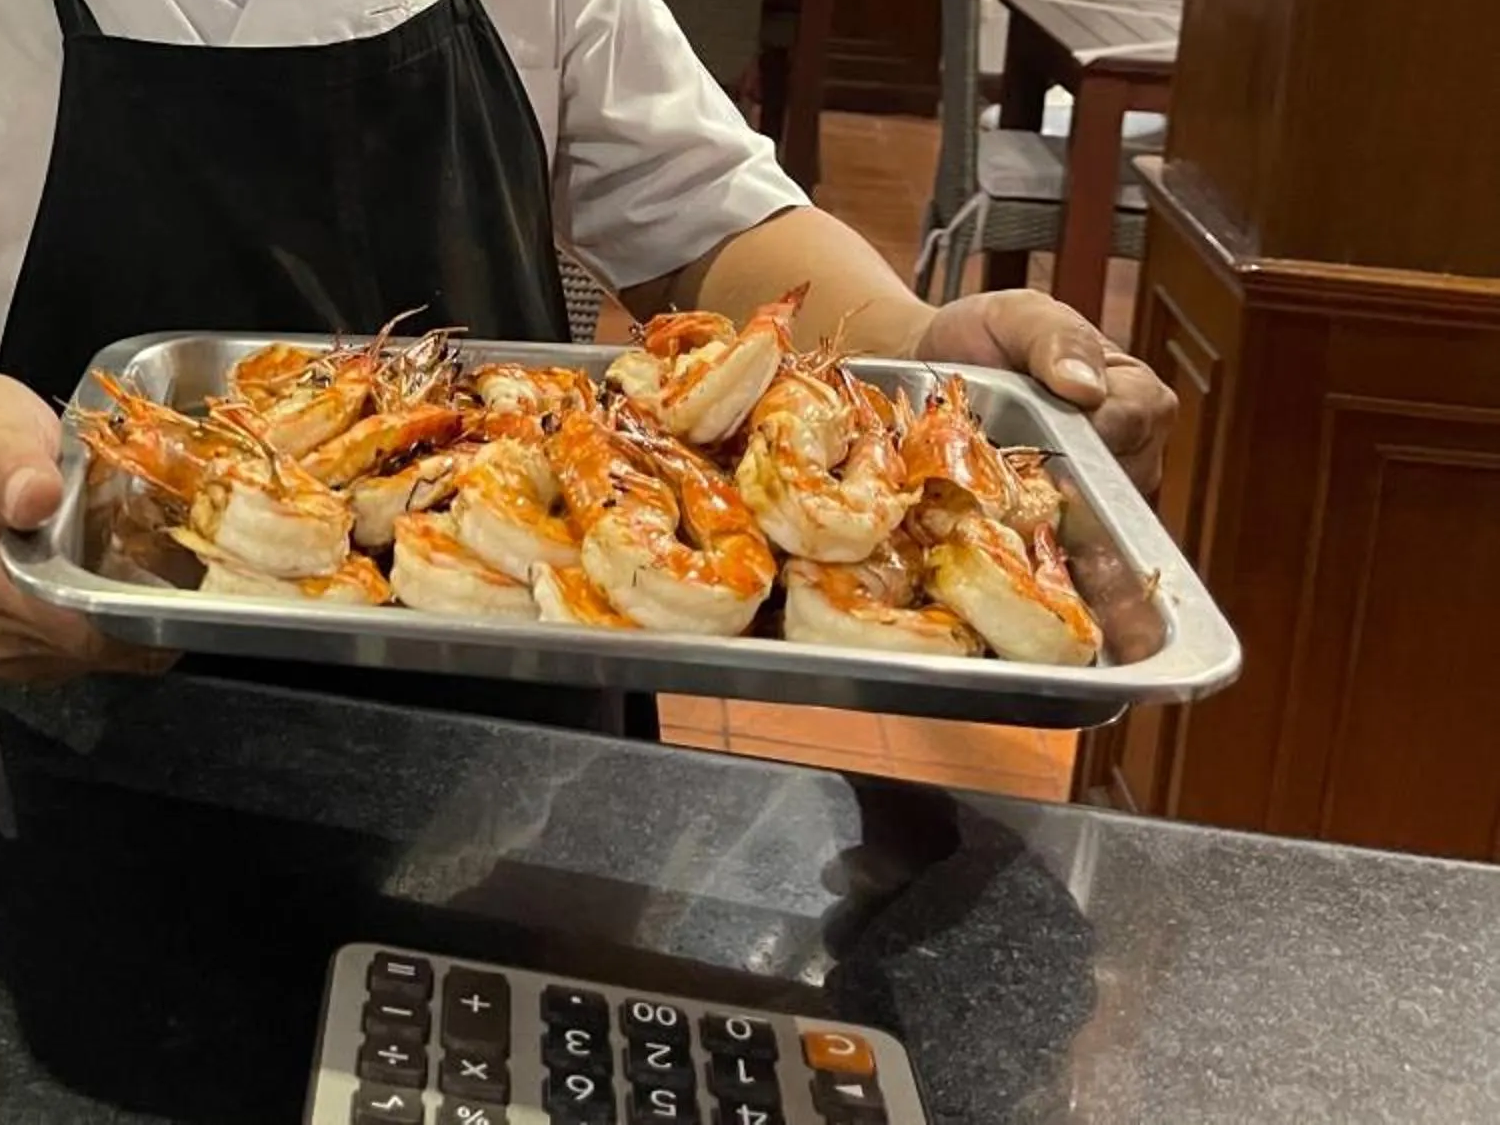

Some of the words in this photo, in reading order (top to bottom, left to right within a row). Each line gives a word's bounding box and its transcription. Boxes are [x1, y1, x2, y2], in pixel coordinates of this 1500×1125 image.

[632, 1002, 678, 1026] 00
[725, 1017, 752, 1040] 0
[564, 1029, 592, 1055] 3
[644, 1041, 673, 1069] 2
[824, 1033, 856, 1056] C
[736, 1057, 757, 1083] 1
[565, 1074, 595, 1101] 6
[649, 1088, 677, 1117] 5
[735, 1103, 768, 1125] 4
